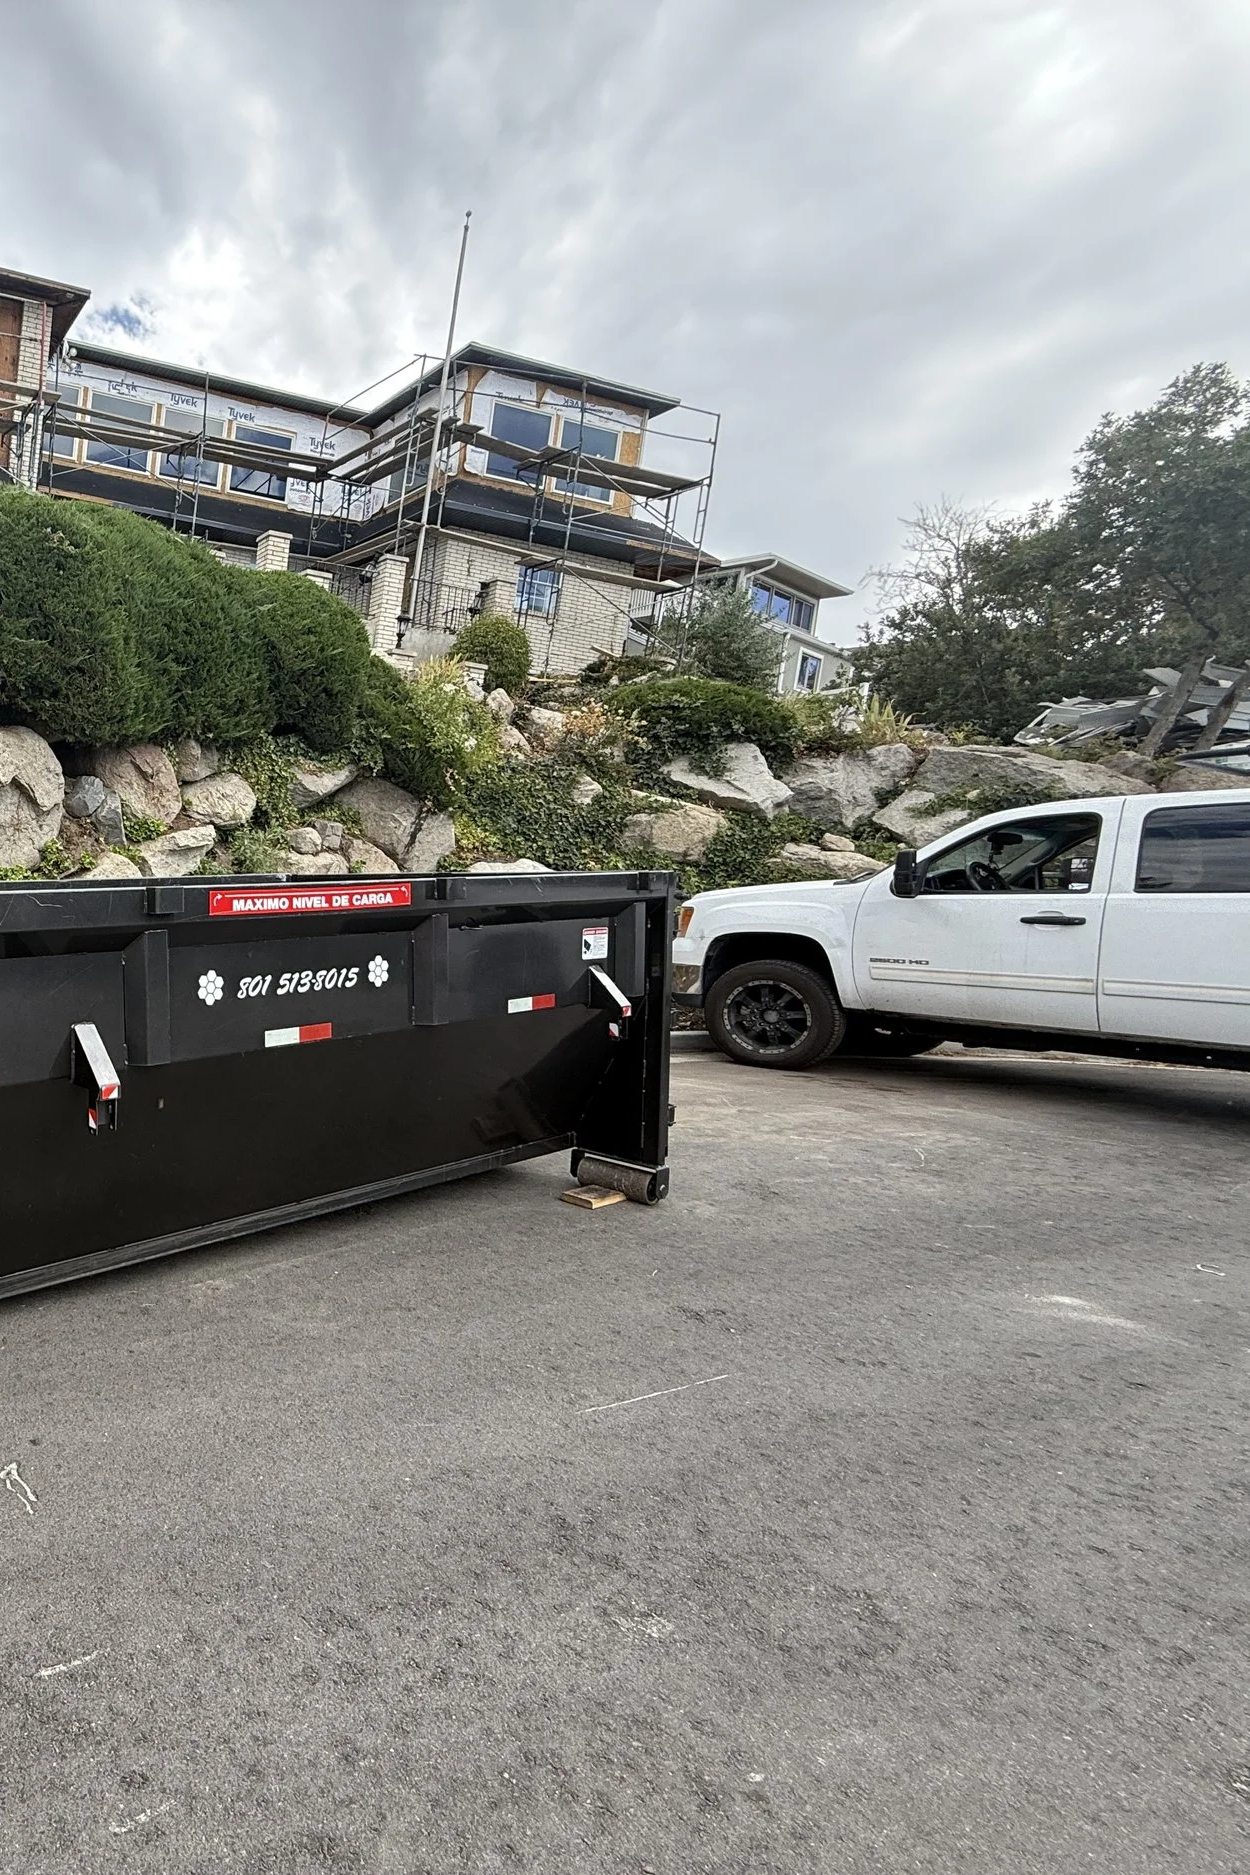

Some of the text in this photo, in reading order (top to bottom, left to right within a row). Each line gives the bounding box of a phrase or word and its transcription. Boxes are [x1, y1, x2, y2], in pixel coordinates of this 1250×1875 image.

[170, 392, 198, 408] Tyvek
[227, 406, 256, 422] Tyvek
[309, 436, 336, 451] Tyvek
[232, 892, 394, 912] MAXIMO NIVEL DE CARGA
[236, 967, 360, 999] 801 513-8015
